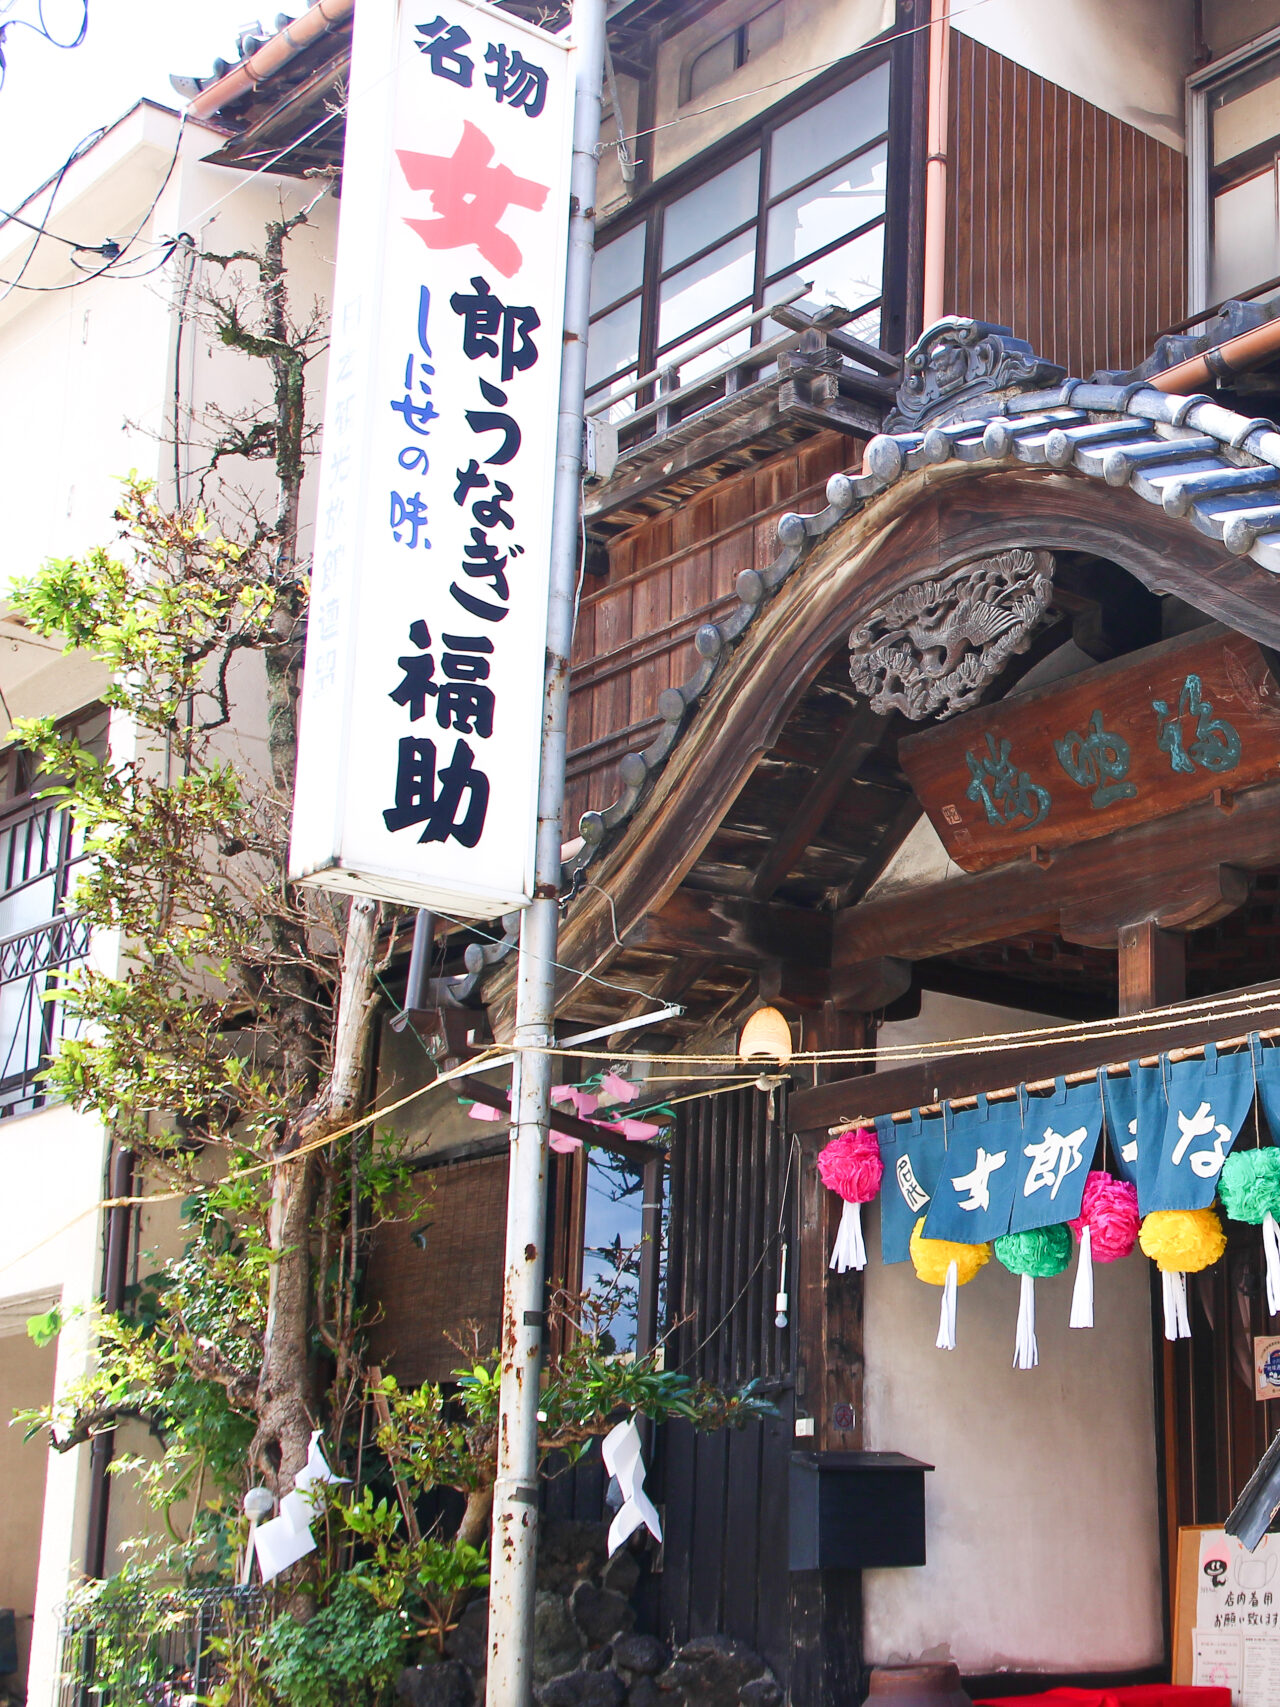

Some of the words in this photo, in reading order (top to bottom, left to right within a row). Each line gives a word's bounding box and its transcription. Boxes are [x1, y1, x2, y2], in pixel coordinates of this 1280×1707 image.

[414, 14, 549, 118] 名物
[382, 118, 552, 849] 女郎うなぎ福助
[387, 284, 440, 552] しにせの味
[1225, 1590, 1273, 1607] 店内着用
